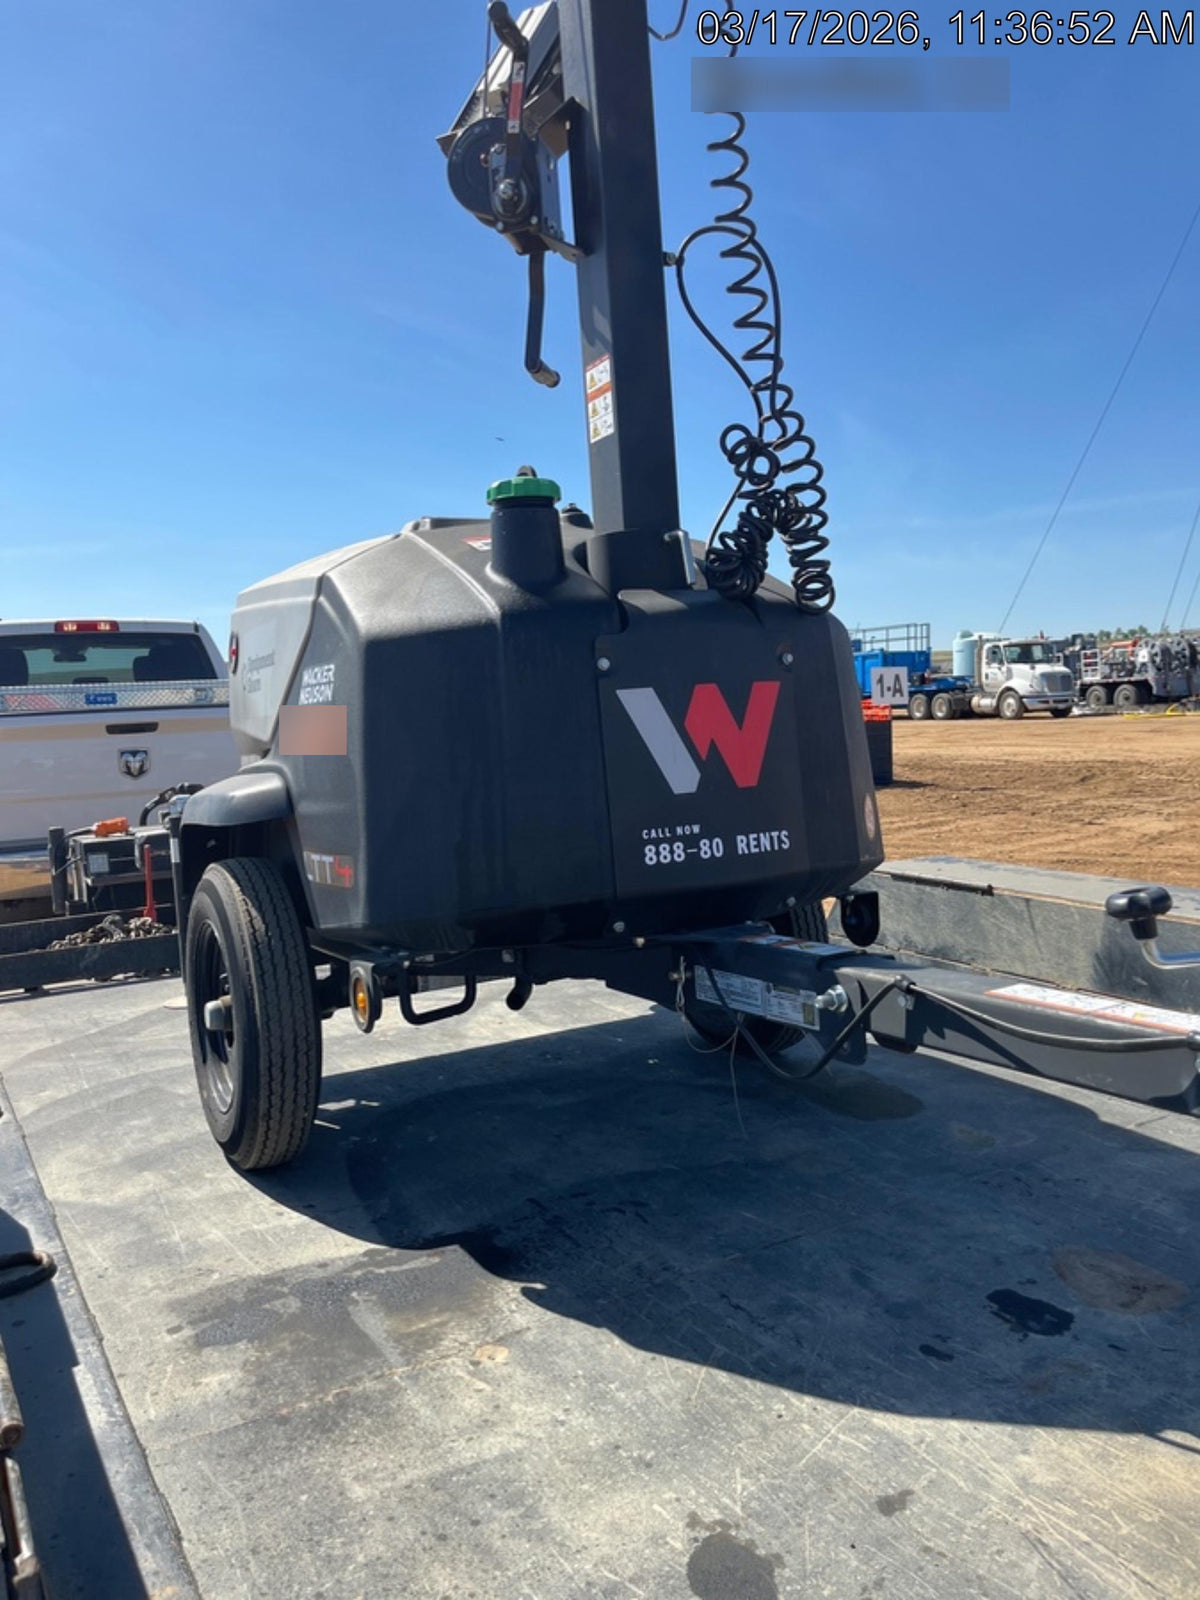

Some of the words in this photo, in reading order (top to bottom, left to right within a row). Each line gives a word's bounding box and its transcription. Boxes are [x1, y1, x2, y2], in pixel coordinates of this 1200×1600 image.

[302, 664, 335, 686] WACKER
[876, 673, 904, 698] 1-A
[299, 682, 333, 705] NEUSON
[642, 828, 672, 840] CALL
[676, 824, 701, 836] NOW
[644, 837, 724, 866] 888-80
[736, 830, 790, 855] RENTS
